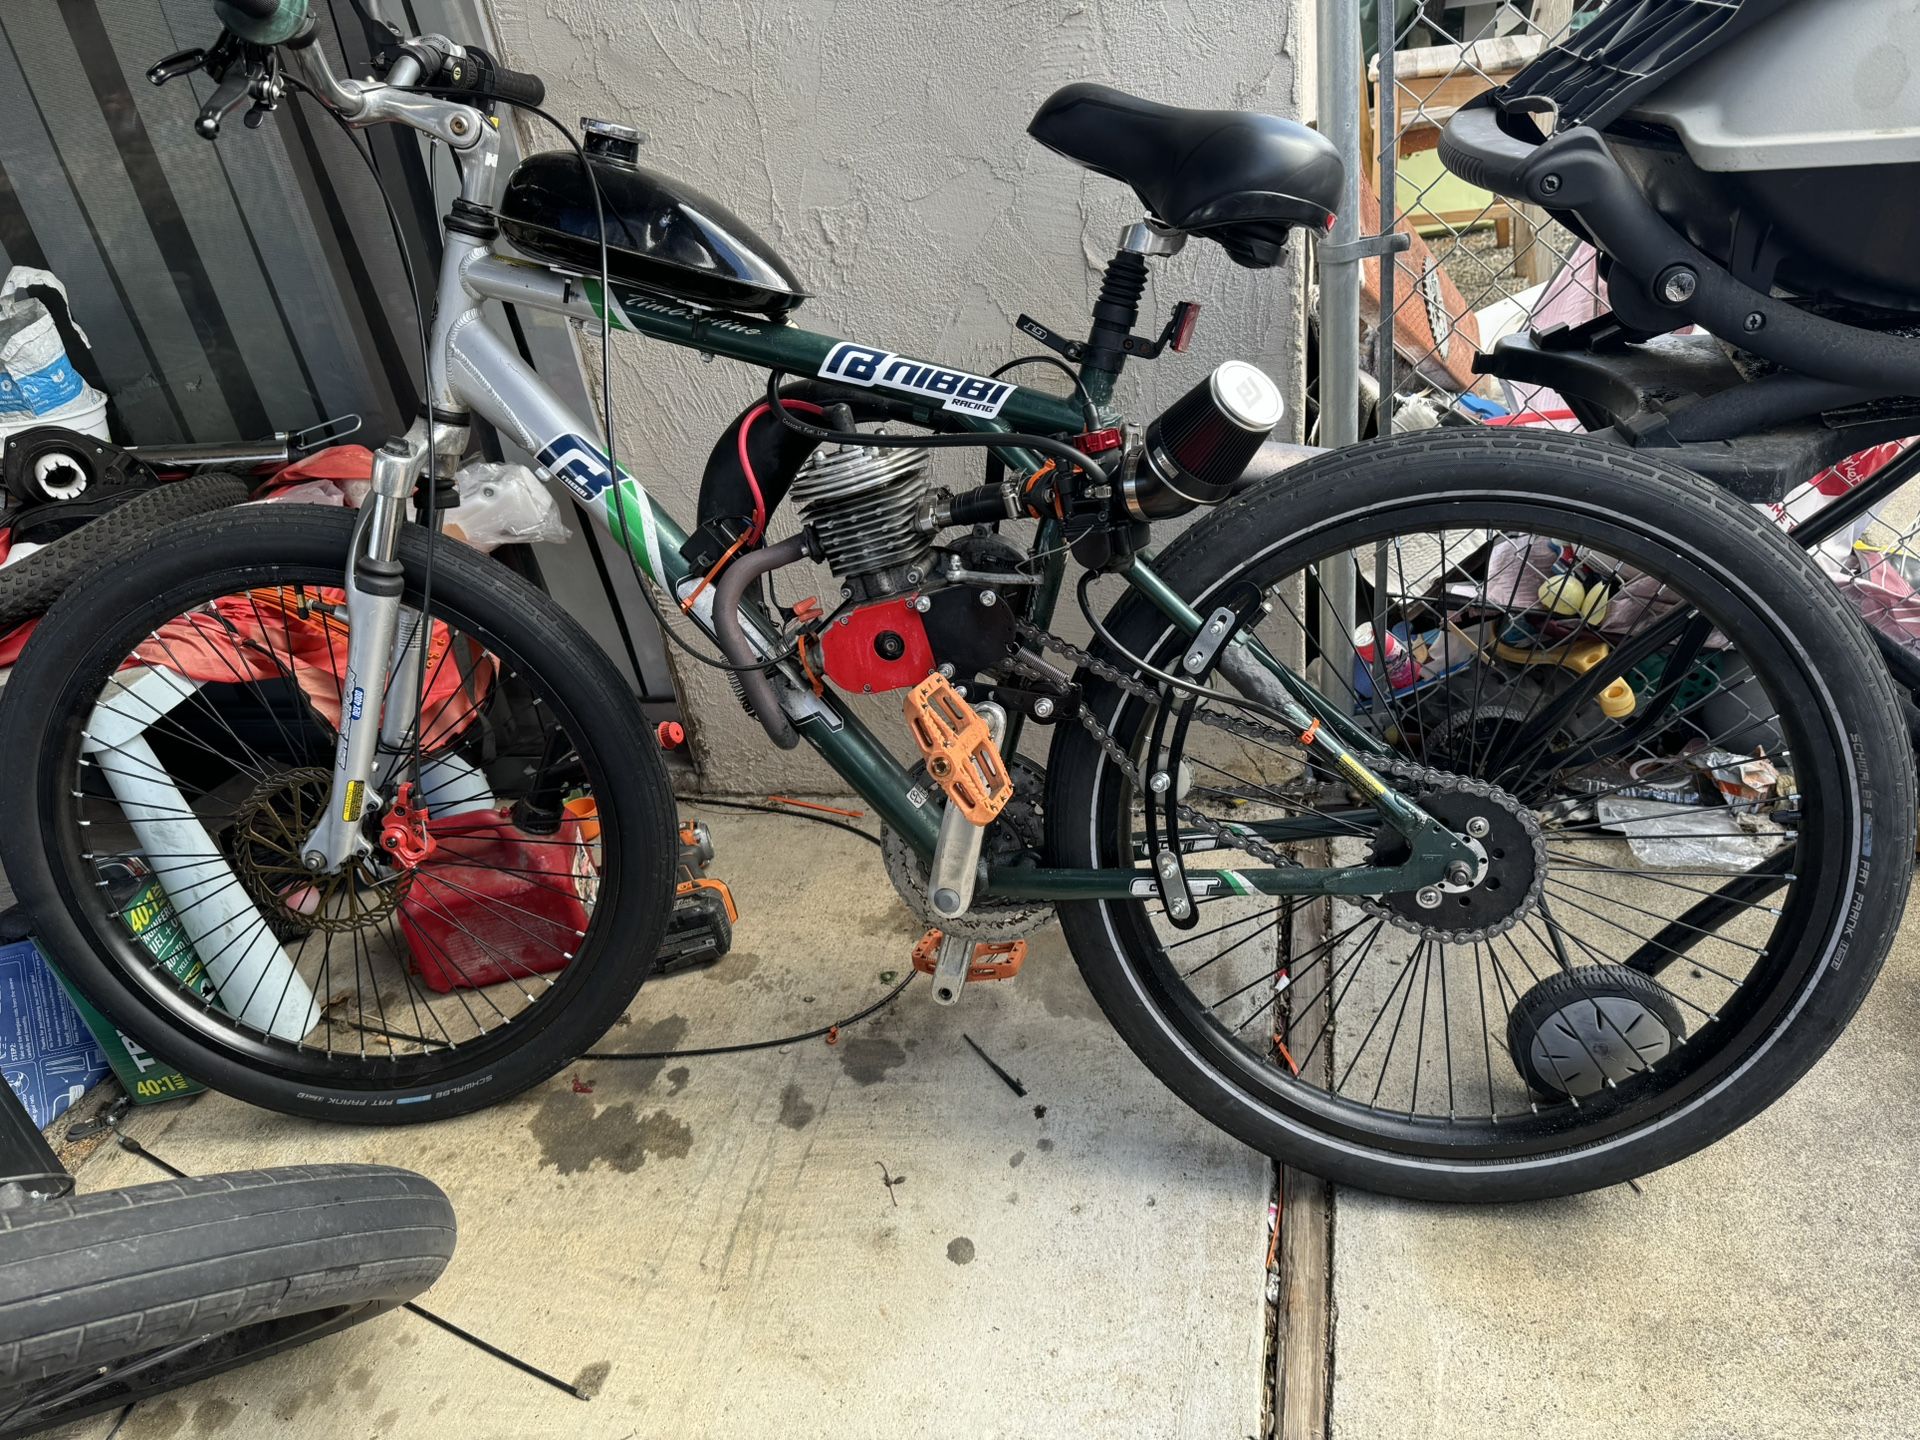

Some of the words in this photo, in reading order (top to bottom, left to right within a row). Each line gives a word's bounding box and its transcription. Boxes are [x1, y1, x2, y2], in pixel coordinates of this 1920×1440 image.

[1023, 322, 1048, 340] GT
[883, 361, 1009, 404] NIBBI
[951, 398, 995, 413] RACING
[1850, 733, 1873, 809] SCHWALBE
[1860, 860, 1871, 885] FAT
[130, 889, 160, 932] 40:1
[1844, 895, 1865, 938] FRANK
[140, 903, 176, 945] NGINEERE
[149, 933, 167, 954] UEL
[136, 1076, 176, 1097] 40:1
[170, 1073, 189, 1090] MIX
[435, 1074, 493, 1099] SCHWALBE
[329, 1097, 368, 1106] FRANK
[371, 1098, 394, 1106] FAT
